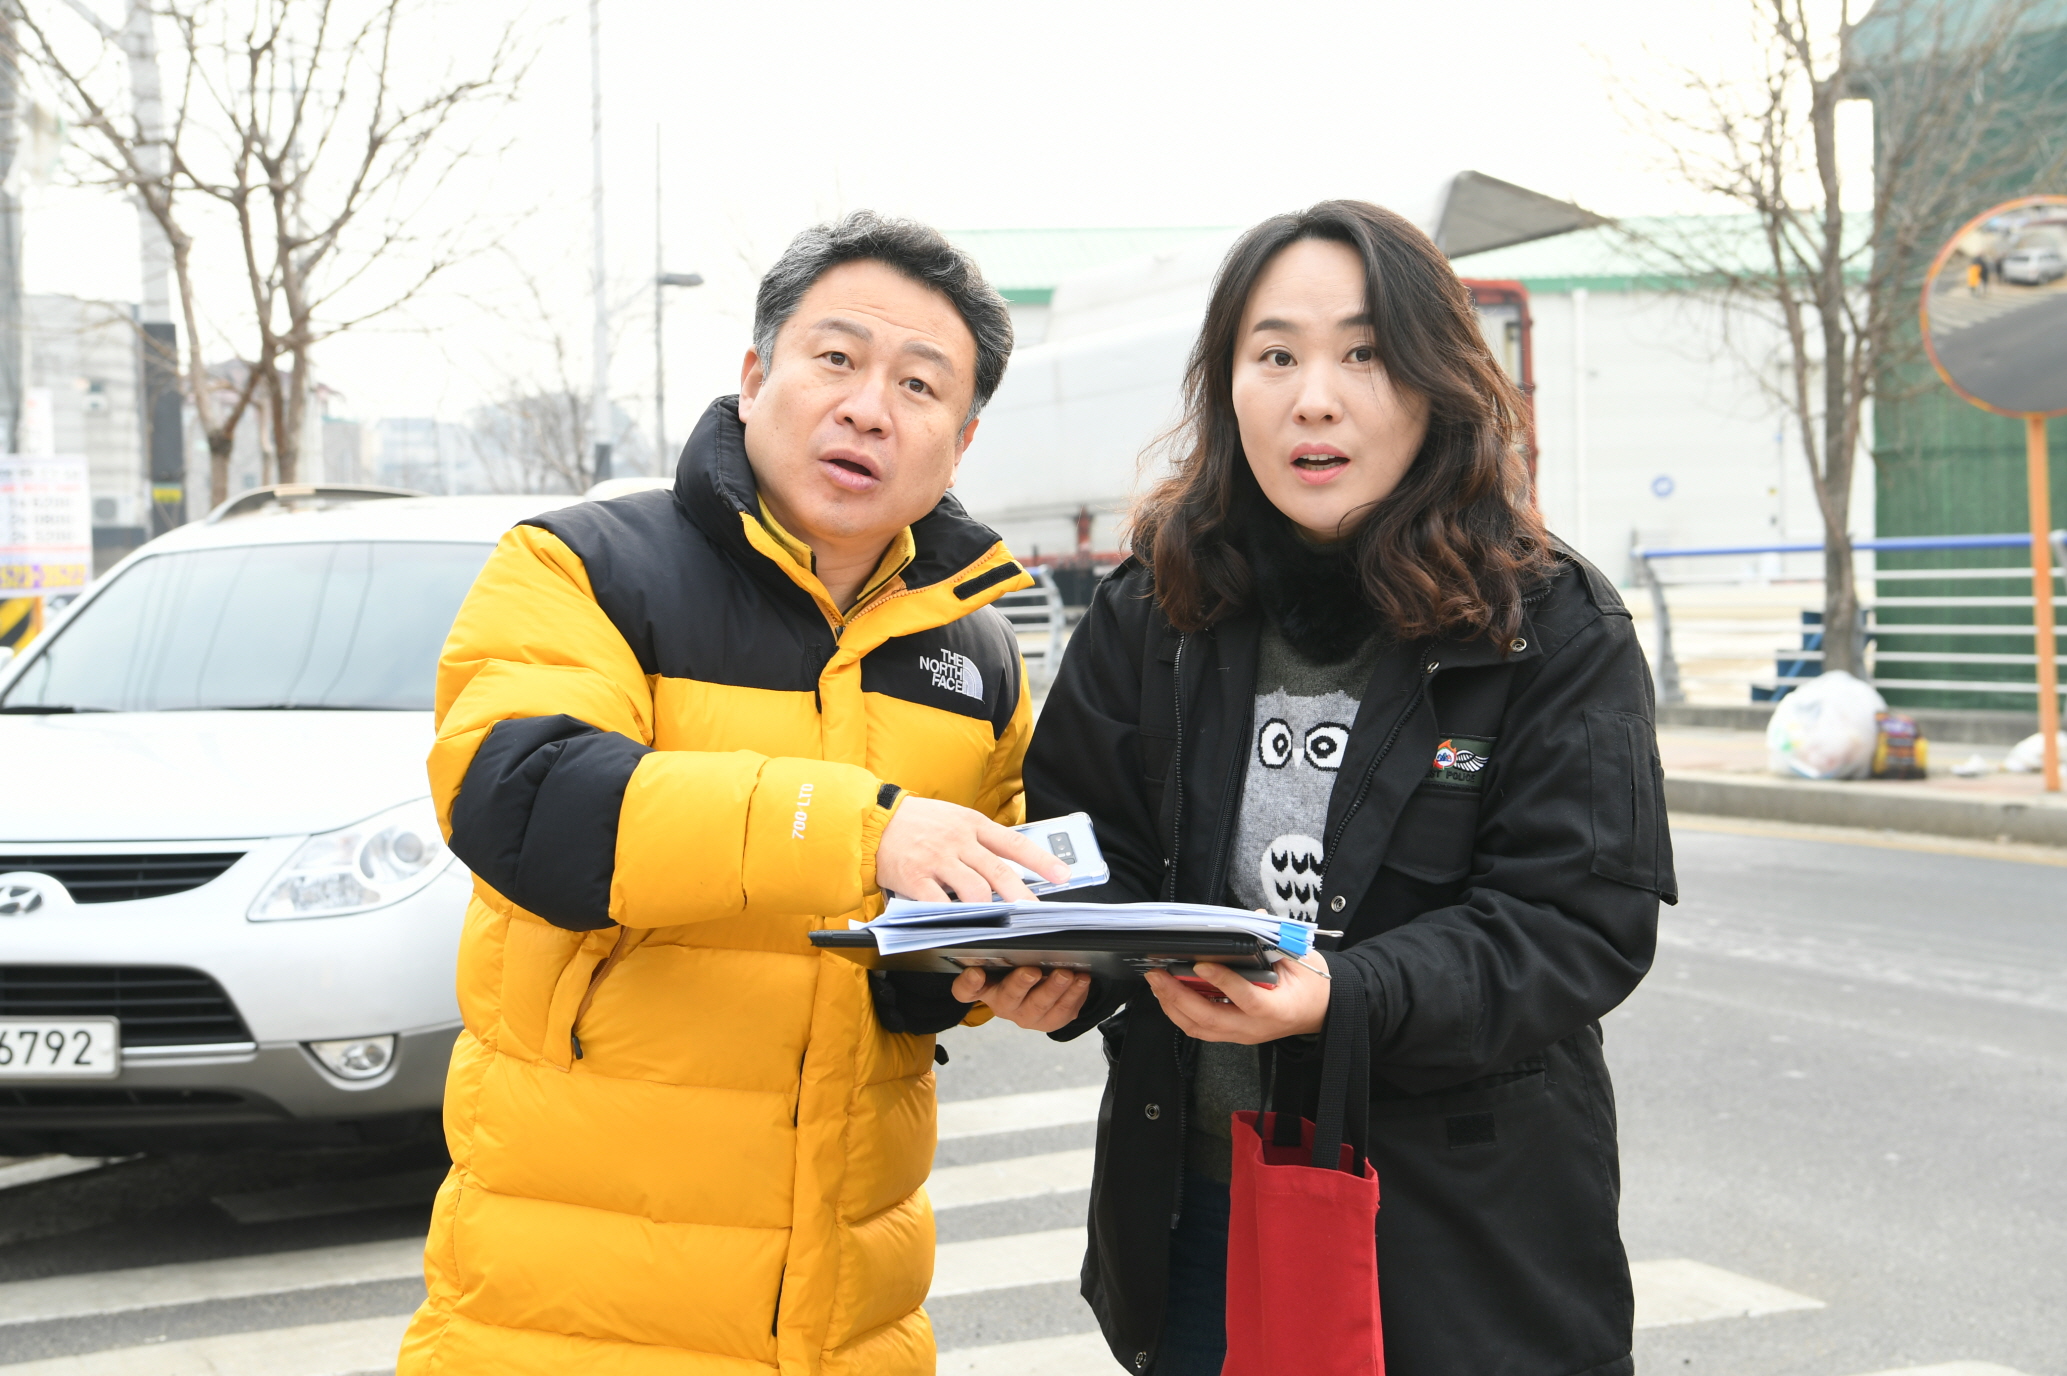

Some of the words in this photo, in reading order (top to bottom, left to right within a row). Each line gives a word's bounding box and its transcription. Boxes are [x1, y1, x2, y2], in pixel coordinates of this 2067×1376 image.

[919, 655, 963, 681] NORTH
[940, 648, 963, 668] THE
[931, 672, 963, 694] FACE
[797, 783, 814, 807] LTD
[792, 811, 807, 840] 700
[0, 1030, 93, 1066] 6792
